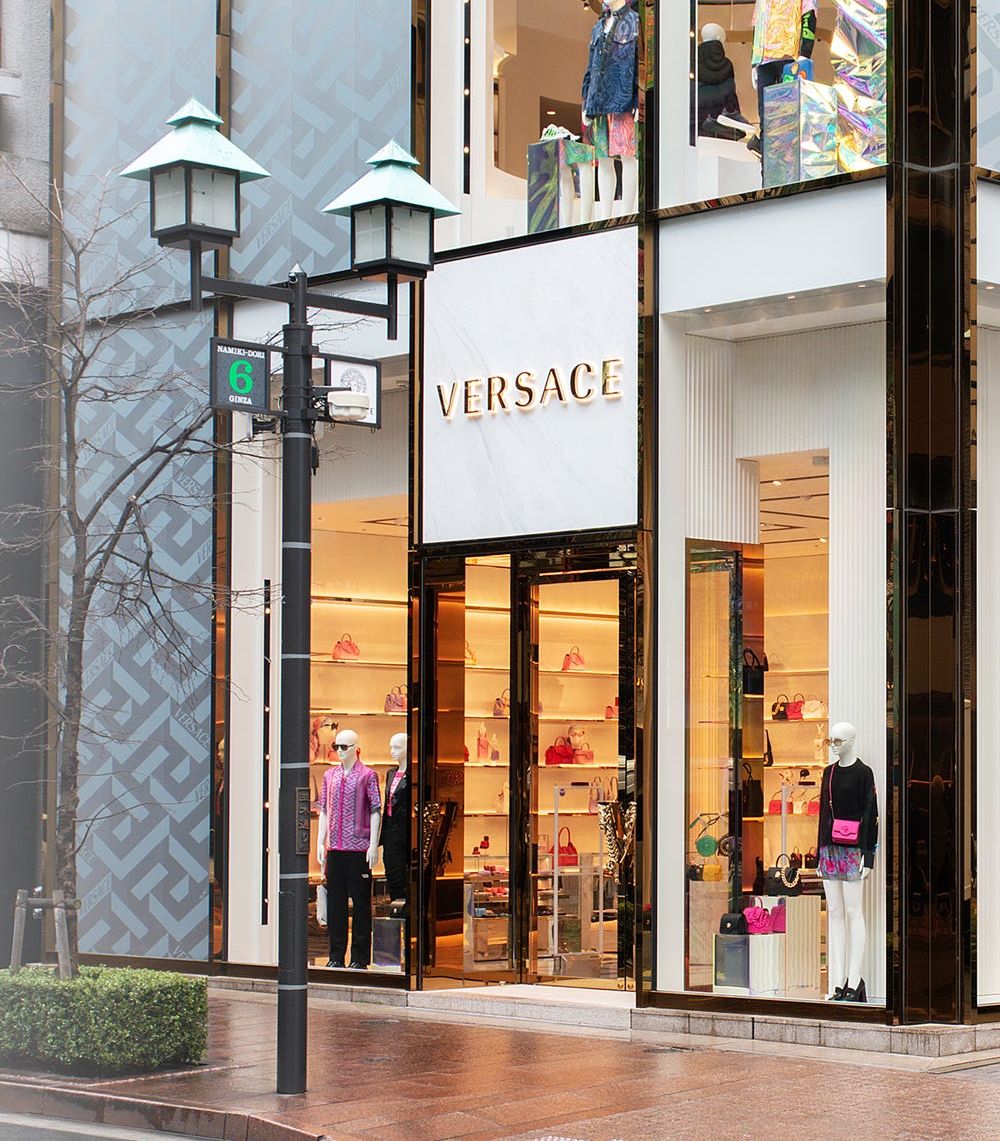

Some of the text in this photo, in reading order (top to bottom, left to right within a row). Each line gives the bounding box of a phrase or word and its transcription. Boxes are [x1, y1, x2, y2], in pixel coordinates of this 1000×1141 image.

[216, 345, 265, 359] NAMIKI-DORI
[229, 359, 254, 395] 6
[436, 358, 624, 419] VERSACE
[228, 395, 253, 405] GINZA
